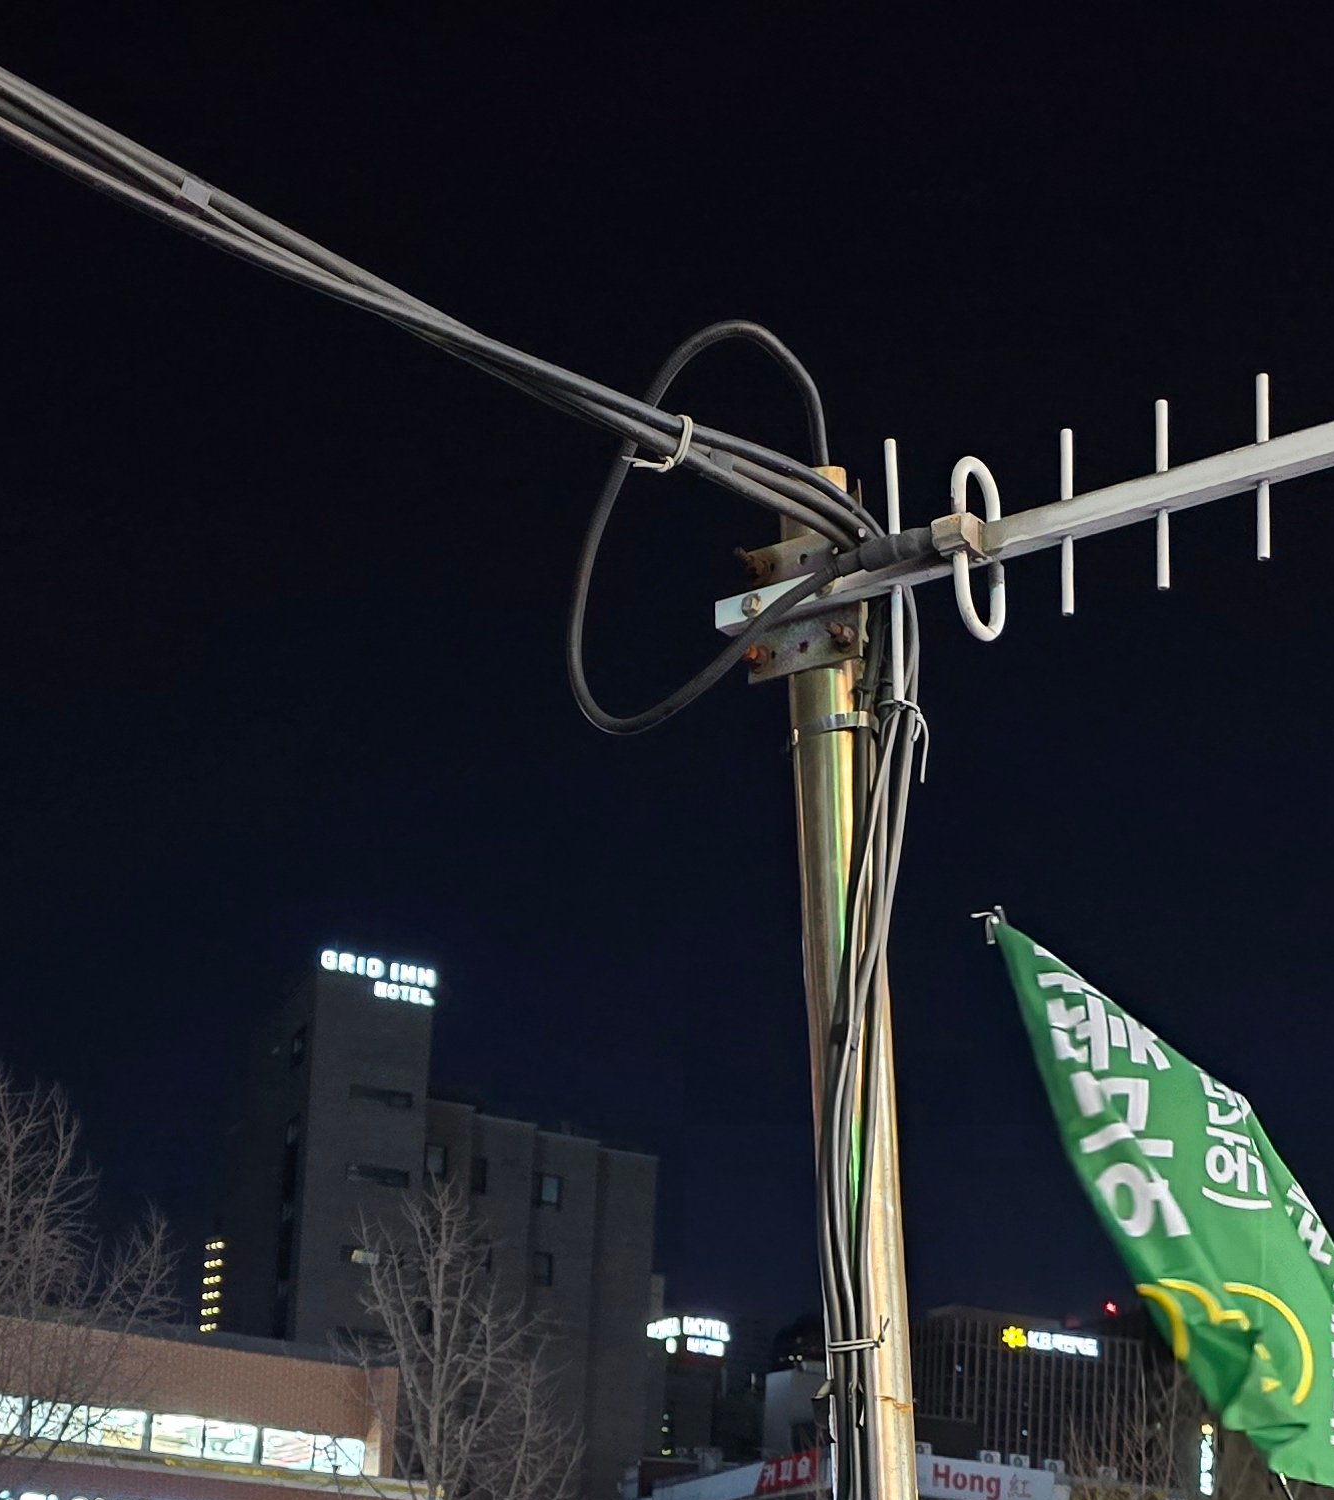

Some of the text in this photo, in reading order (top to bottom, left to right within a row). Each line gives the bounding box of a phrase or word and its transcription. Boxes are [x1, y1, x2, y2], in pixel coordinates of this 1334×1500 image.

[320, 949, 437, 989] GRID INN
[373, 980, 435, 1007] HOTEL
